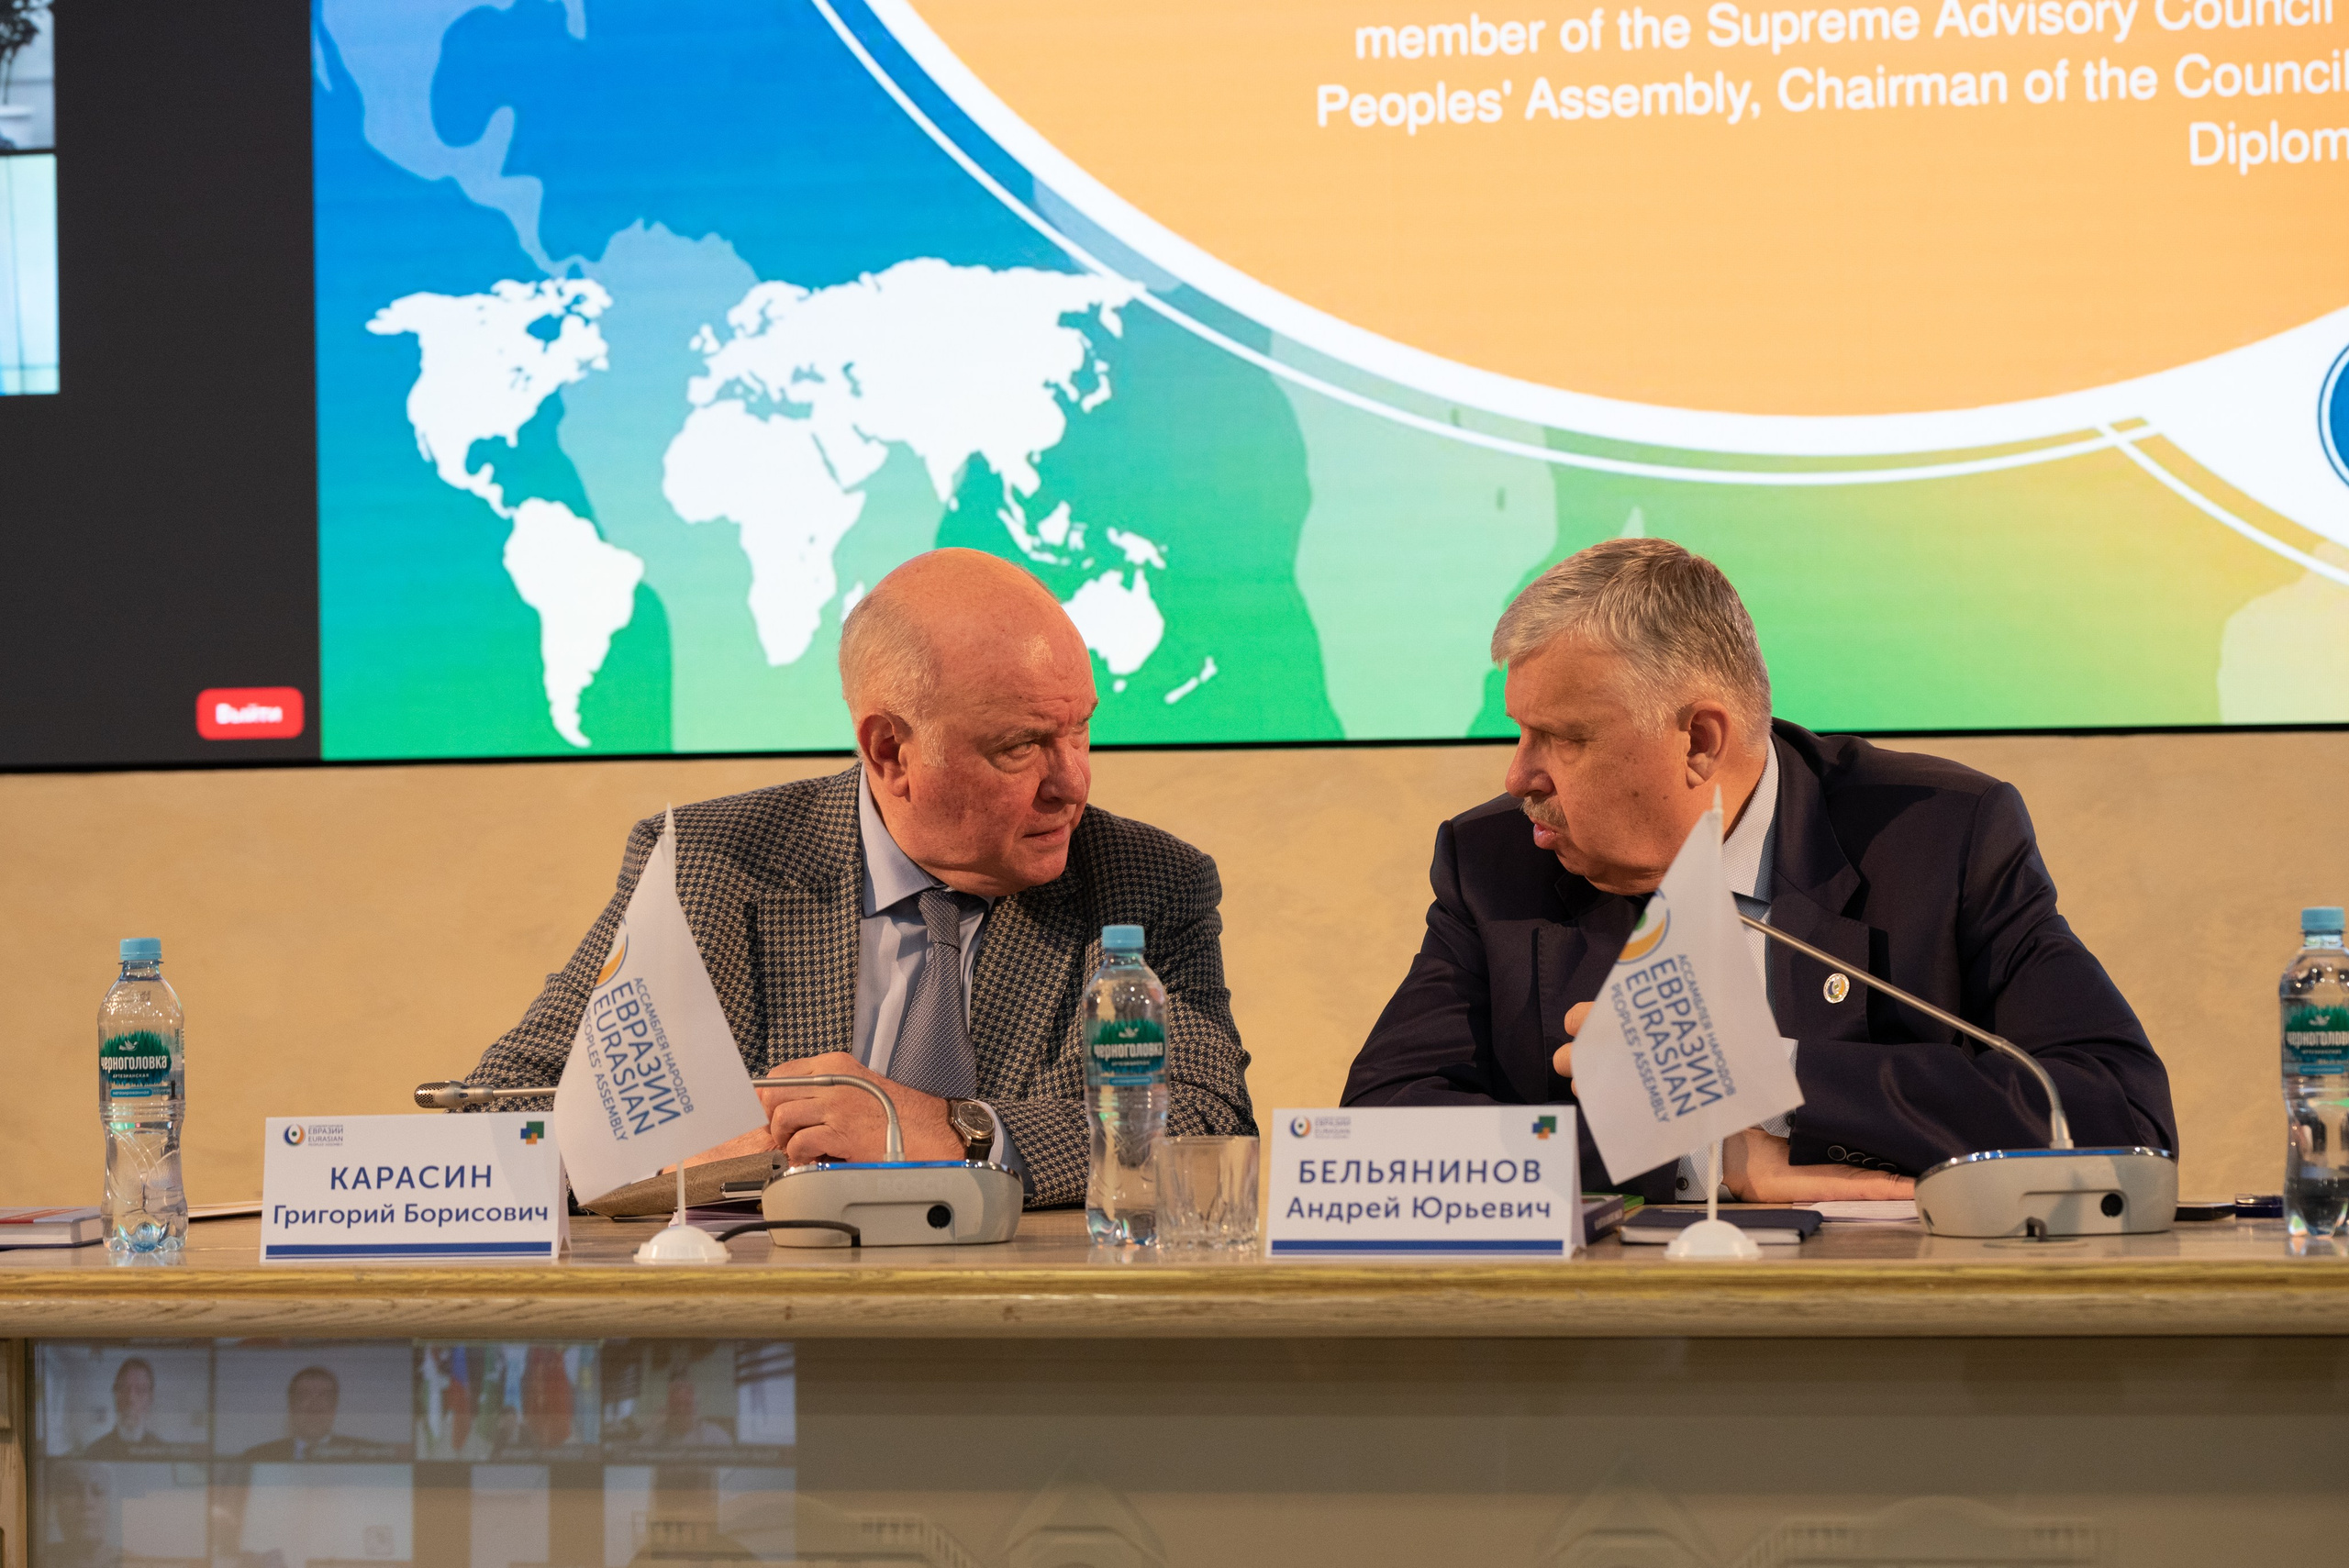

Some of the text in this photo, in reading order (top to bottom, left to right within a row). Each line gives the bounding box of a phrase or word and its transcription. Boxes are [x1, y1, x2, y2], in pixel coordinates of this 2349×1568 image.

[1354, 13, 1546, 60] member
[1559, 6, 1606, 54] of
[1616, 5, 1692, 52] the
[1706, 1, 1921, 56] Supreme
[1932, 0, 2139, 44] Advisory
[1316, 78, 1513, 137] Peoples'
[1523, 70, 1762, 126] Assembly,
[1776, 63, 2009, 113] Chairman
[2023, 57, 2070, 105] of
[2082, 55, 2159, 103] the
[594, 994, 657, 1136] EURASIAN
[610, 980, 682, 1127] ЕВРАЗИИ
[633, 977, 695, 1115] АССАМБЛЕЯ НАРОДОВ
[1625, 970, 1698, 1118] EURASIAN
[1649, 958, 1724, 1107] ЕВРАЗИИ
[307, 1127, 344, 1135] ЕВРАЗИИ
[595, 1073, 629, 1141] ASSEMBLY
[329, 1164, 493, 1191] КАРАСИН
[1298, 1159, 1542, 1184] БЕЛЬЯНИНОВ
[273, 1202, 549, 1229] Григорий Борисович
[1286, 1195, 1552, 1225] Андрей Юрьевич
